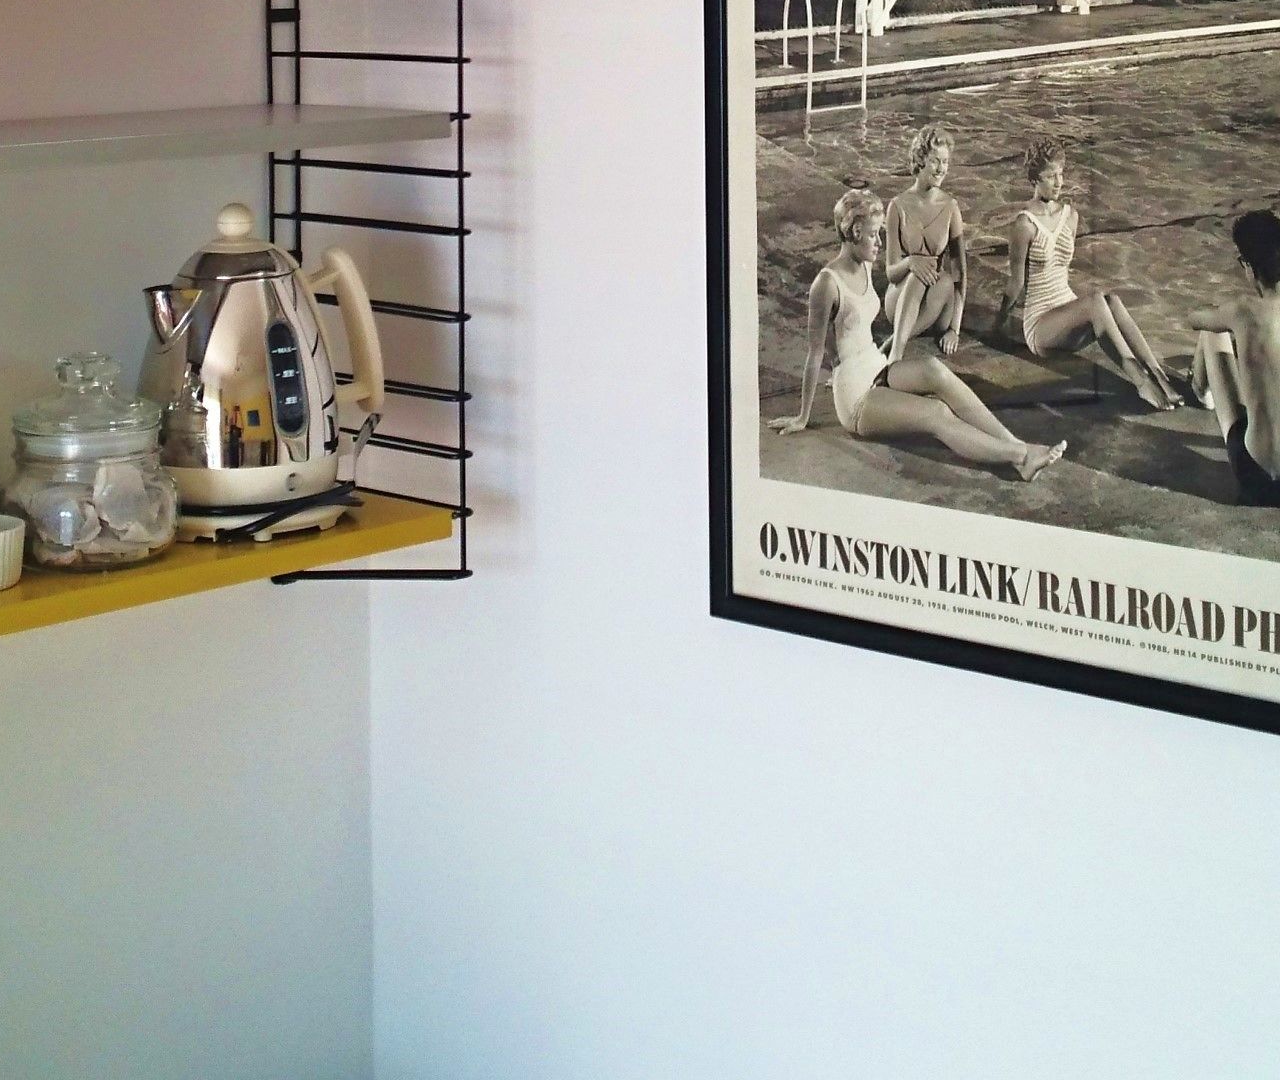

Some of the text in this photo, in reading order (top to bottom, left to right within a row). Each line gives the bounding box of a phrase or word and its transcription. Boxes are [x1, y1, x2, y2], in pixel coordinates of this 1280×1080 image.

[759, 521, 932, 589] O.WINSTON
[877, 591, 909, 603] AUGUST
[952, 605, 997, 620] SWIMMING
[998, 614, 1023, 626] POOL,
[1026, 619, 1059, 633] WELCH,
[1061, 626, 1084, 638] WEST
[1088, 632, 1135, 647] VIRGINIA.
[1200, 653, 1254, 670] PUBLISHED
[1256, 664, 1268, 673] BY
